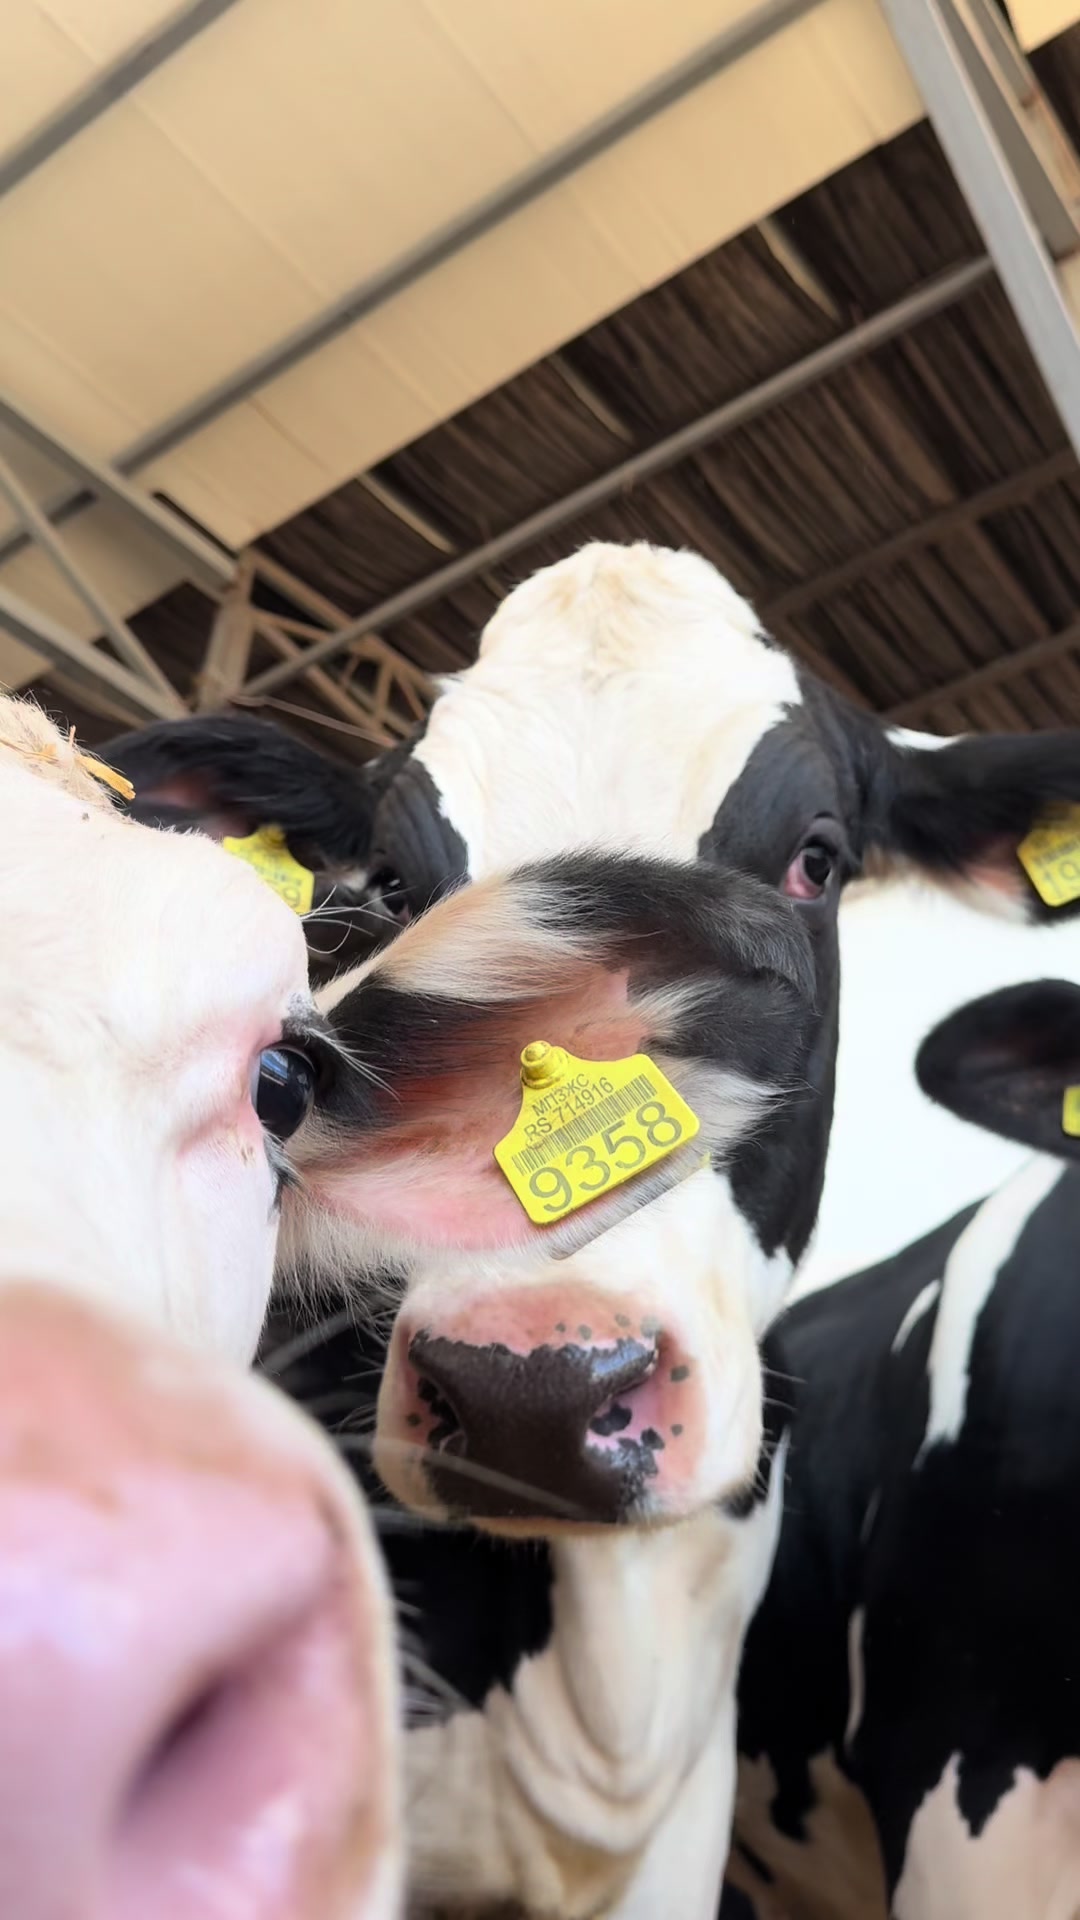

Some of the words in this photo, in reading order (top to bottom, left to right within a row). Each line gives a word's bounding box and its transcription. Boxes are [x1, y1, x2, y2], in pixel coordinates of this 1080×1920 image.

[524, 1117, 552, 1142] RS
[552, 1077, 614, 1123] 714916
[529, 1101, 682, 1213] 9358
